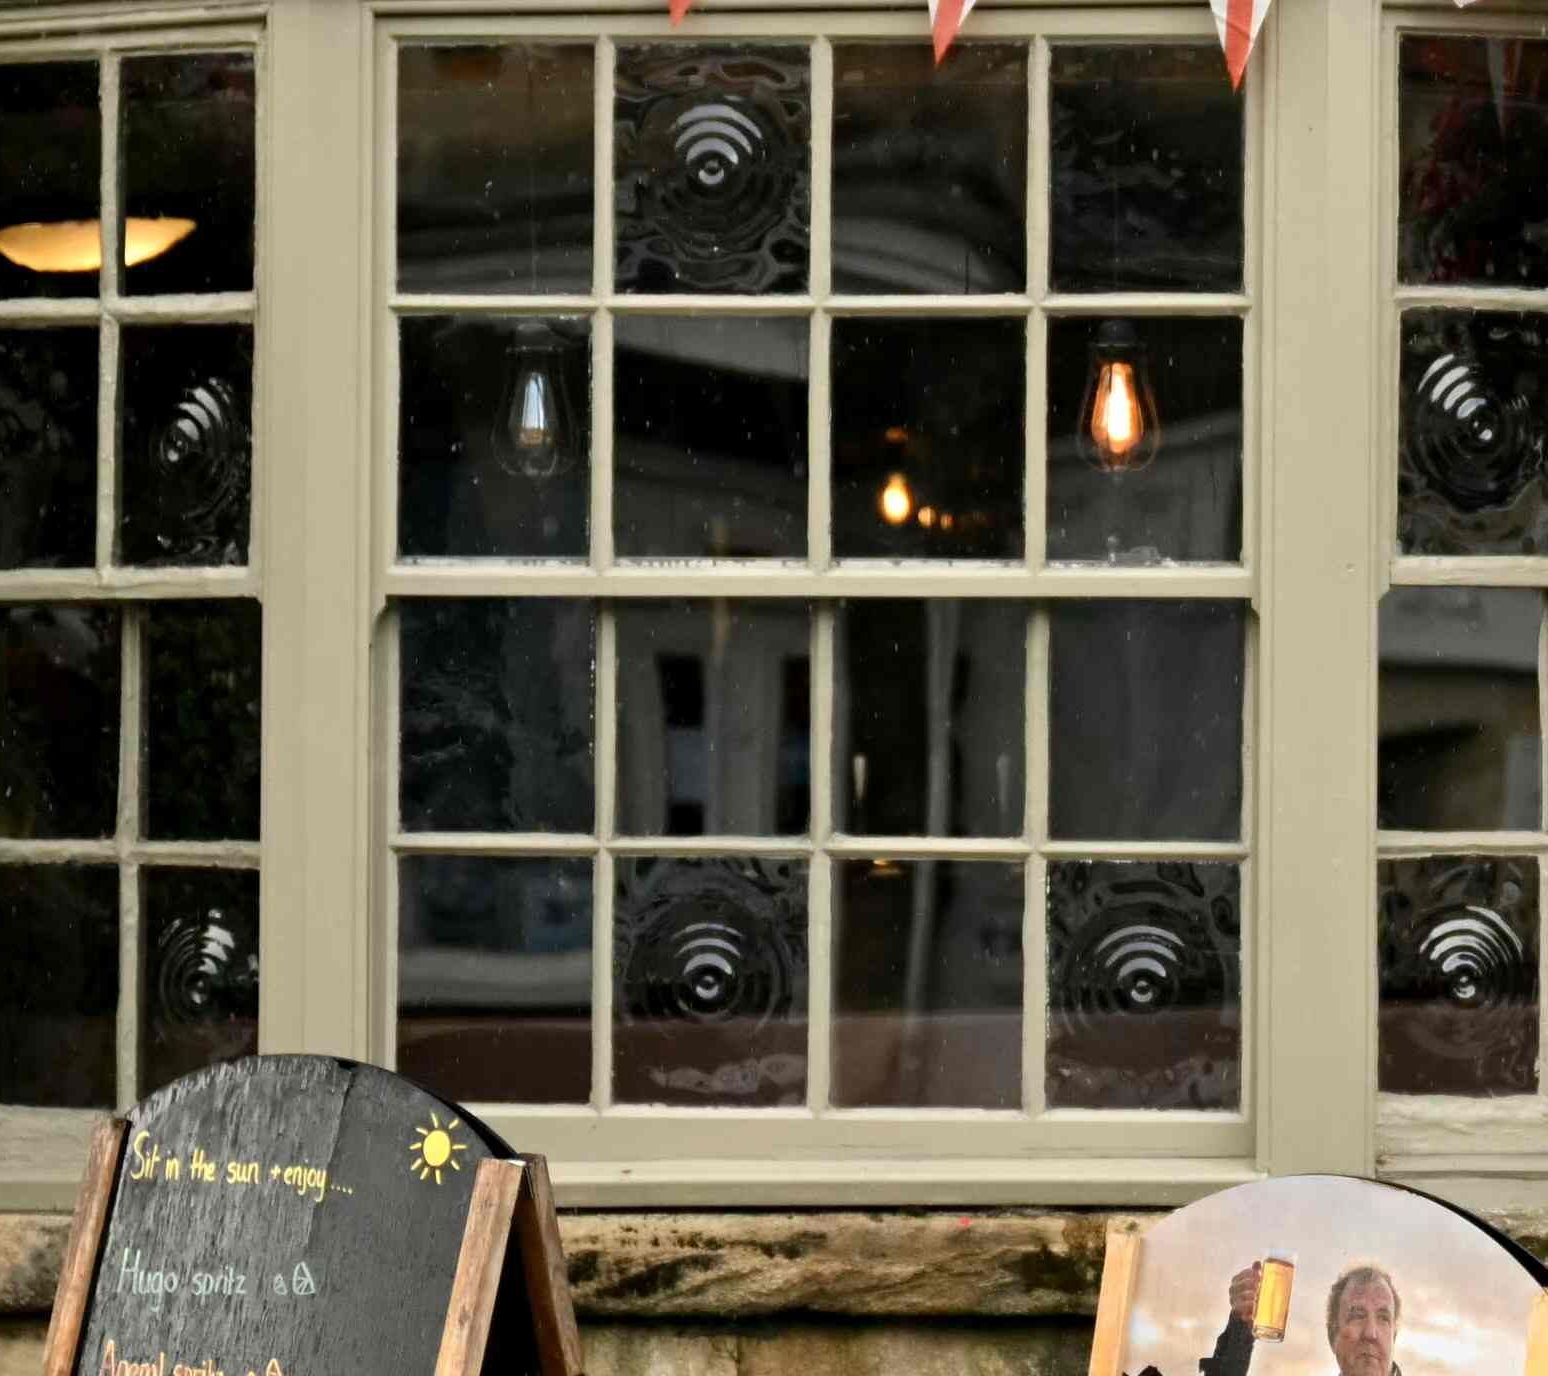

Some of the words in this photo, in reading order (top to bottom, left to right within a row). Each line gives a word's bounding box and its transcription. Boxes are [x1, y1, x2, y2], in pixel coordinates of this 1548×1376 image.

[131, 1130, 161, 1180] Sit
[165, 1150, 179, 1181] in
[190, 1148, 216, 1183] the
[227, 1161, 259, 1185] sun
[117, 1247, 179, 1313] Hugo
[192, 1264, 247, 1305] spritz
